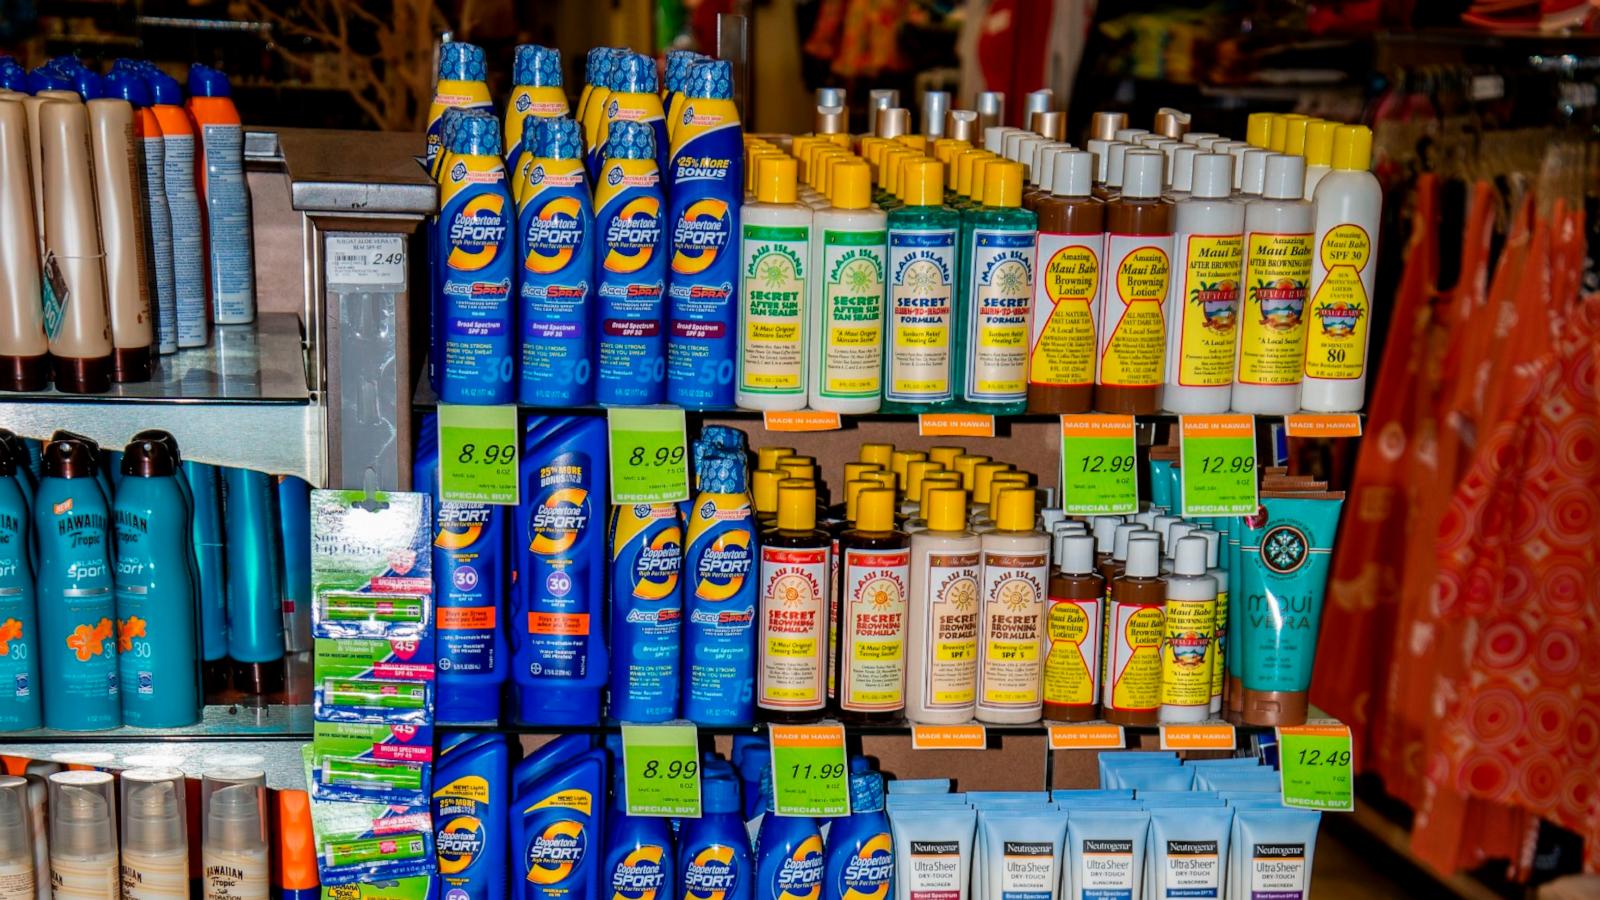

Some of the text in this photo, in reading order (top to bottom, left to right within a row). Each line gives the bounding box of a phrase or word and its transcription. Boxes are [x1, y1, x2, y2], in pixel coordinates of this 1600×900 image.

[677, 167, 726, 178] BONUS
[455, 213, 501, 226] Coppertone
[532, 216, 577, 230] Coppertone
[612, 216, 656, 230] Coppertone
[678, 218, 721, 231] Coppertone
[450, 225, 505, 240] SPORT
[528, 228, 582, 244] SPORT
[607, 228, 660, 243] SPORT
[674, 229, 726, 245] SPORT
[1273, 237, 1305, 246] Amazing
[1061, 253, 1090, 262] Amazing
[1133, 254, 1162, 263] Amazing
[1198, 248, 1229, 258] Maui
[1330, 252, 1362, 260] SPF 30
[373, 253, 403, 265] 2.49
[1050, 263, 1075, 273] Maui
[1121, 264, 1147, 274] Maui
[1055, 275, 1092, 288] Browning
[1127, 276, 1164, 289] Browning
[750, 291, 799, 301] SECRET
[1059, 287, 1085, 295] Lotion
[1131, 287, 1157, 296] Lotion
[750, 301, 798, 309] AFTER SUN
[833, 295, 880, 305] SECRET
[897, 298, 946, 307] SECRET
[984, 298, 1030, 307] SECRET
[750, 308, 798, 317] TAN SEALER
[866, 306, 880, 314] SUN
[833, 313, 852, 321] TAN
[476, 321, 500, 329] Spectrum
[693, 324, 718, 332] Spectrum
[1327, 350, 1346, 363] 80
[482, 356, 513, 383] 30
[699, 358, 734, 385] 50
[458, 444, 516, 465] 8.99
[629, 446, 685, 466] 8.99
[1082, 456, 1135, 473] 12.99
[1202, 456, 1255, 474] 12.99
[663, 491, 683, 499] BUY
[538, 505, 581, 516] Coppertone
[1068, 503, 1134, 512] SPECIAL BUY
[1232, 504, 1252, 512] BUY
[437, 510, 490, 522] SPORT
[533, 515, 586, 529] SPORT
[71, 532, 100, 548] Tropic
[643, 547, 680, 558] Coppertone
[704, 548, 747, 560] Coppertone
[637, 557, 681, 570] SPORT
[699, 559, 751, 572] SPORT
[67, 563, 106, 580] sport
[456, 573, 476, 585] 30
[549, 578, 570, 590] 30
[768, 609, 815, 619] SECRET
[856, 613, 902, 622] SECRET
[1170, 608, 1192, 616] Maui
[769, 618, 814, 627] BROWNING
[940, 613, 977, 624] SECRET
[992, 615, 1038, 624] SECRET
[1251, 616, 1310, 630] VERA
[768, 625, 809, 633] FORMULA
[856, 622, 900, 630] BROWNING
[1051, 623, 1083, 632] Browning
[991, 631, 1036, 639] FORMULA
[1053, 630, 1075, 638] Lotion
[11, 643, 27, 659] 30
[134, 642, 150, 657] 30
[395, 640, 415, 651] 45
[399, 746, 427, 754] SPECTRUM
[1299, 749, 1351, 766] 12.49
[643, 760, 698, 780] 8.99
[792, 763, 845, 779] 11.99
[1286, 797, 1348, 807] SPECIAL BUY
[438, 830, 475, 841] Coppertone
[437, 840, 481, 852] SPORT
[535, 837, 577, 848] Coppertone
[914, 843, 959, 853] Neutrogena
[1086, 841, 1131, 851] Neutrogena
[1169, 842, 1216, 853] Neutrogena
[530, 848, 582, 860] SPORT
[1007, 843, 1052, 854] Neutrogena
[1256, 845, 1302, 857] Neutrogena
[784, 857, 823, 869] Coppertone
[851, 854, 892, 867] Coppertone
[206, 865, 243, 880] HAWAIIAN
[617, 863, 660, 874] Coppertone
[688, 862, 730, 874] Coppertone
[845, 865, 894, 880] SPORT
[613, 873, 664, 887] SPORT
[685, 873, 735, 887] SPORT
[778, 868, 824, 883] SPORT
[211, 876, 236, 888] Tropic
